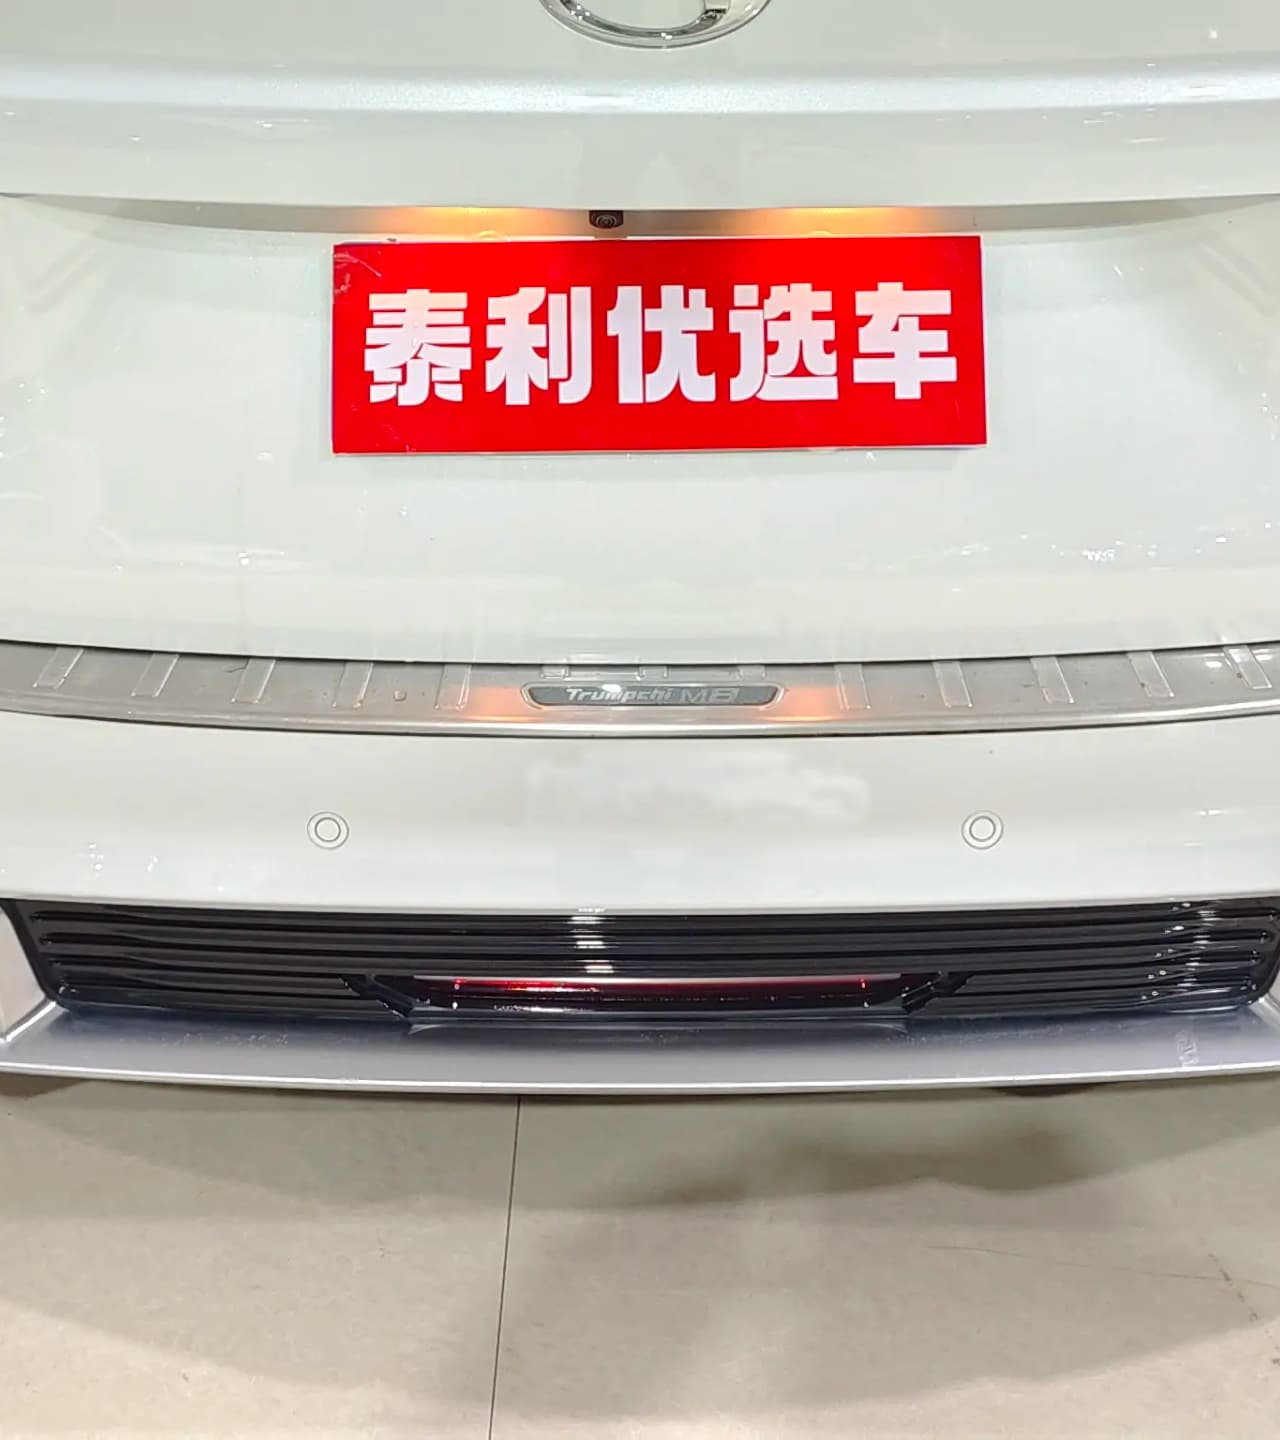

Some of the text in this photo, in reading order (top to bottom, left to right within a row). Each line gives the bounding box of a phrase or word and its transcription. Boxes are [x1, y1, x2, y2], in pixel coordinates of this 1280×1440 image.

[363, 281, 958, 408] 泰利优选车
[565, 687, 673, 704] Trumpchi
